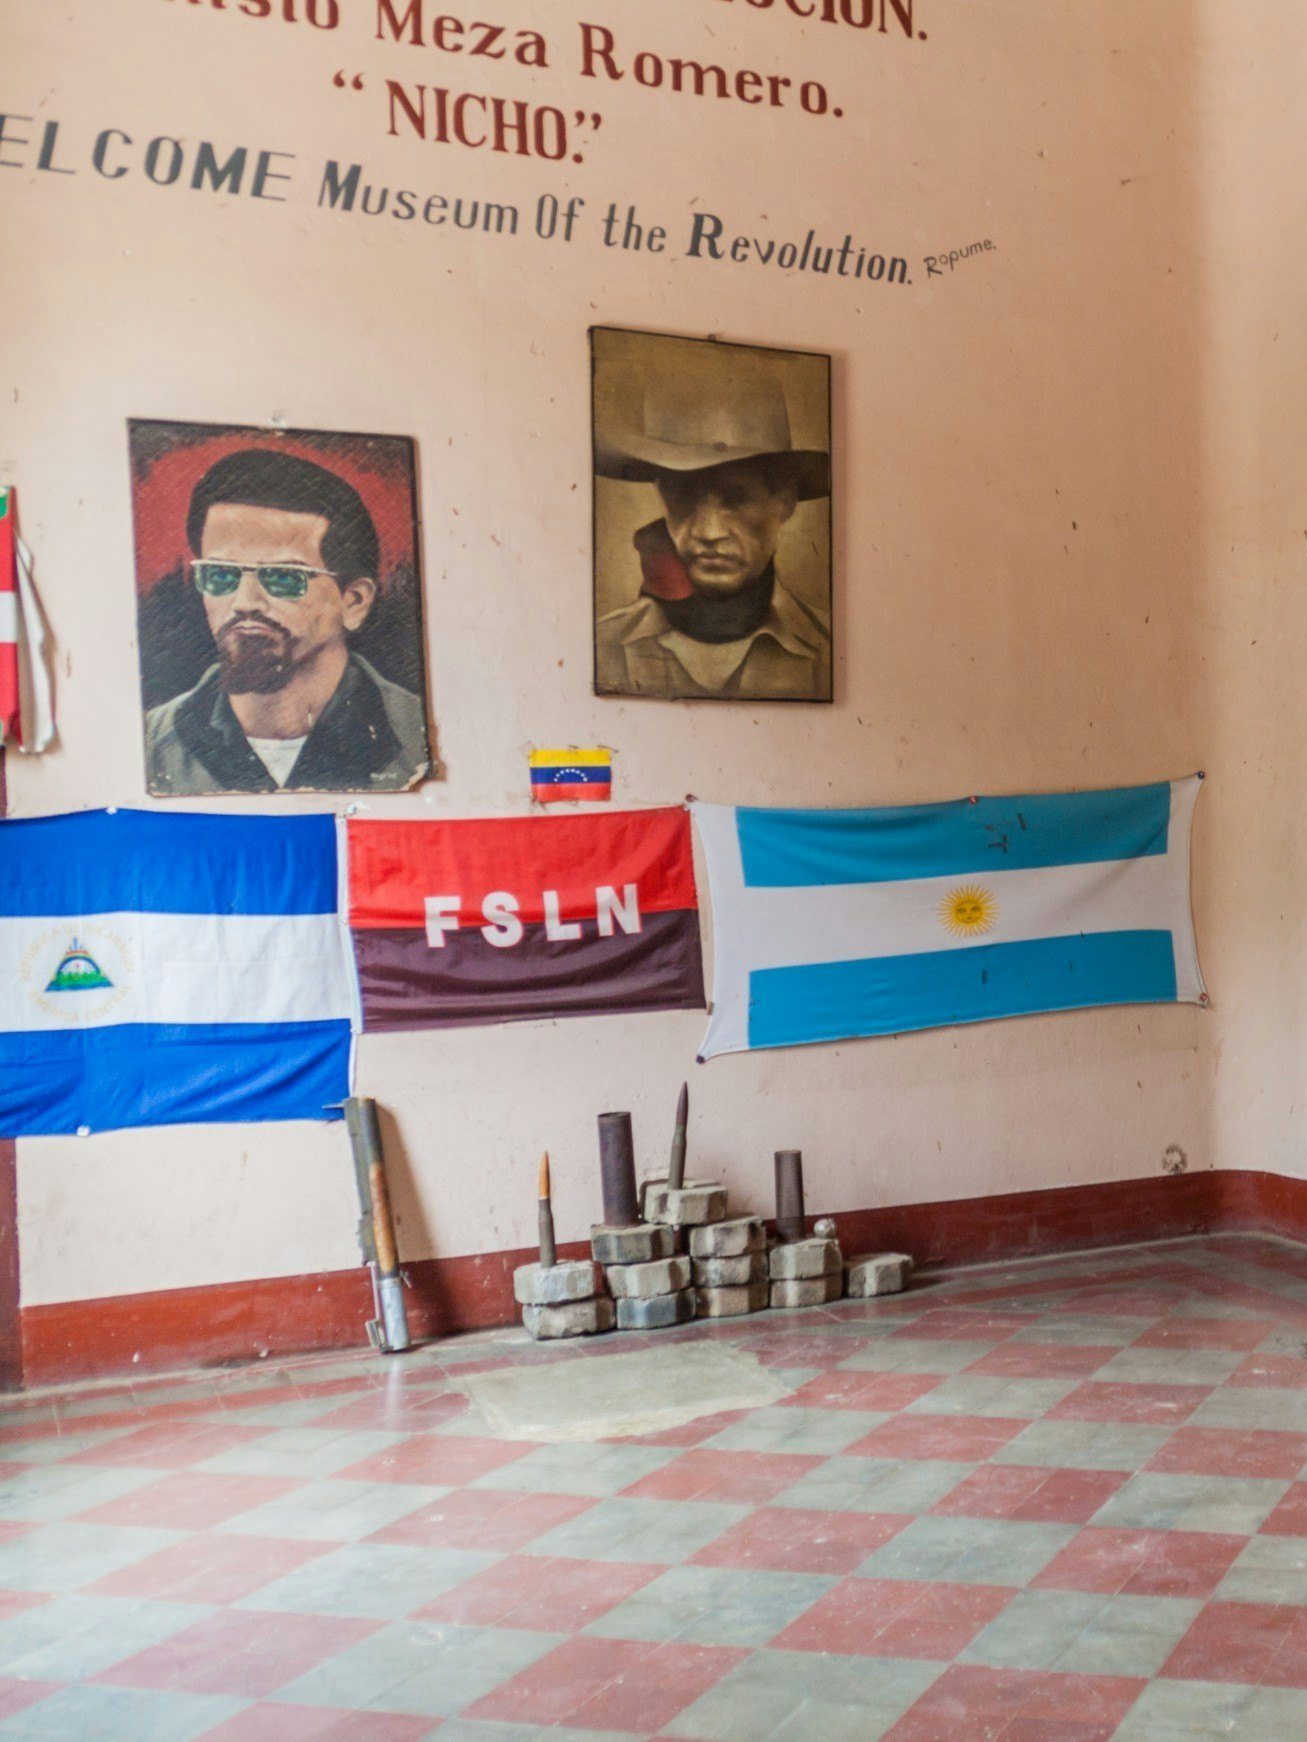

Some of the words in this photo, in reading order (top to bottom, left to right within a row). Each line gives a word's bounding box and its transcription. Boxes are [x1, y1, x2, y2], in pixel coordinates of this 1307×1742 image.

[376, 0, 549, 68] Meza
[578, 22, 844, 119] Romero.
[317, 160, 519, 236] Museum
[534, 193, 586, 243] Of
[602, 203, 667, 254] the
[685, 212, 914, 286] Revolution.
[423, 883, 643, 948] FSLN
